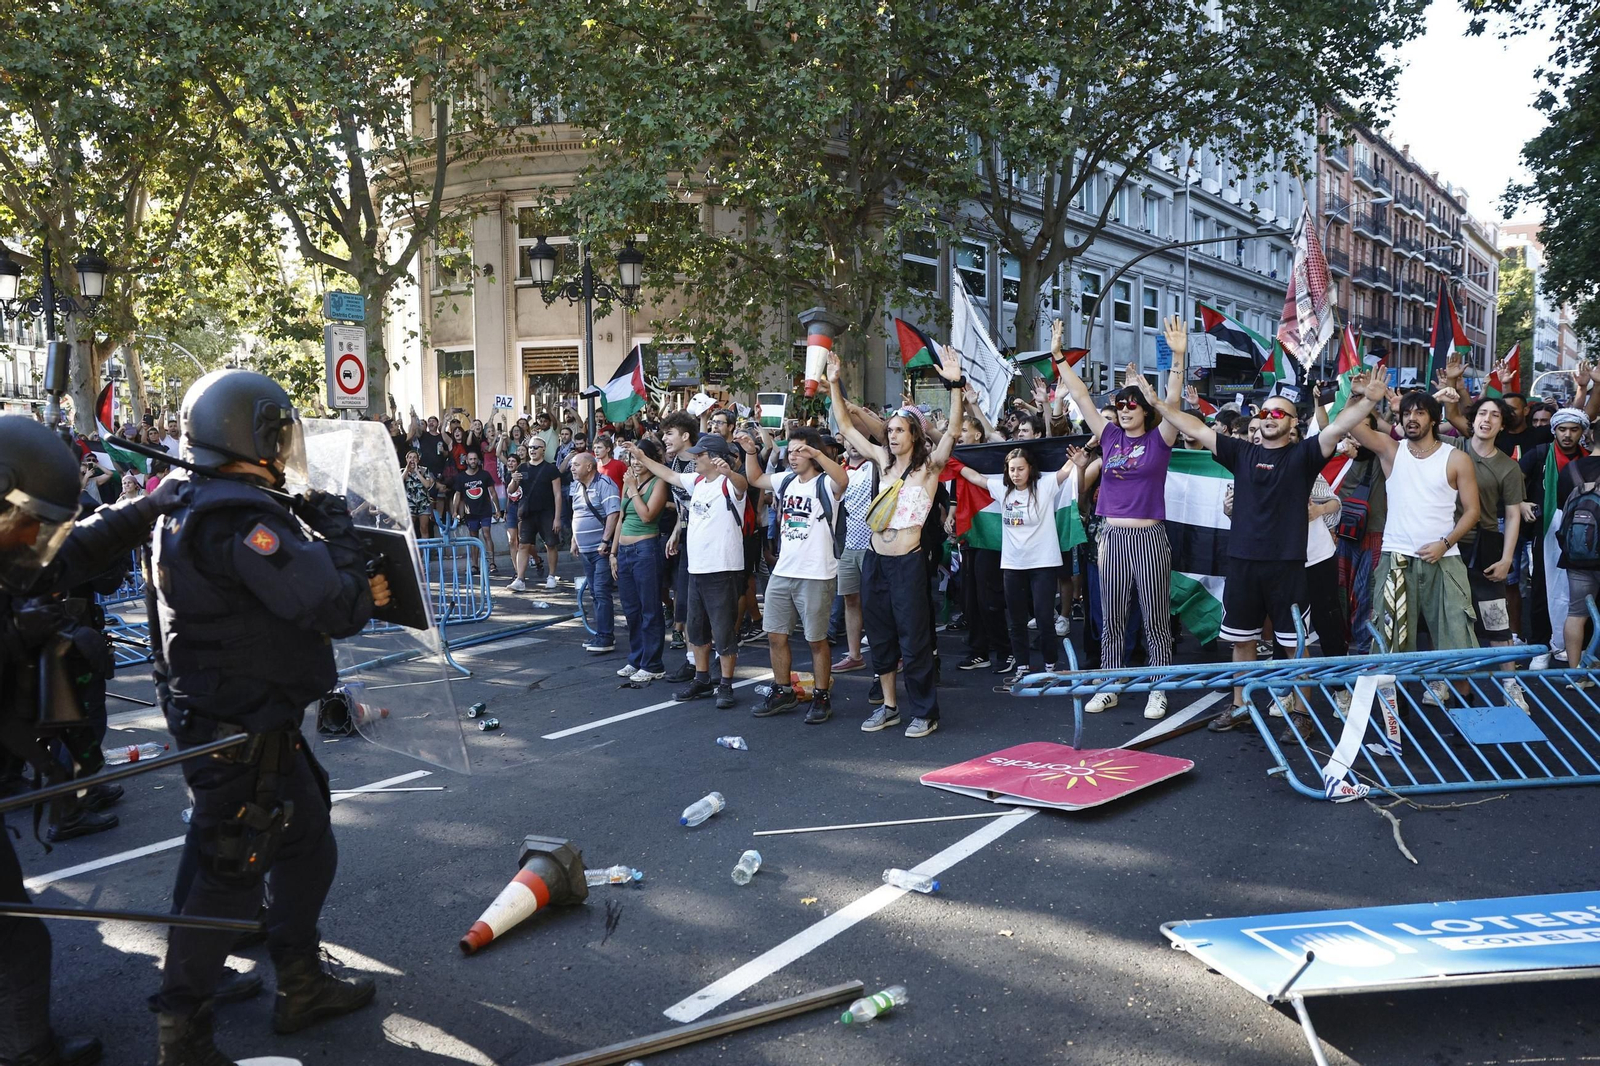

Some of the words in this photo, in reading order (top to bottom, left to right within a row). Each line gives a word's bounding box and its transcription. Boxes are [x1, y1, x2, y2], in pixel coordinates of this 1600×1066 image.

[495, 396, 513, 408] PAZ
[986, 757, 1095, 776] Cofidis
[1462, 935, 1535, 946] CON
[1540, 933, 1583, 941] EL
